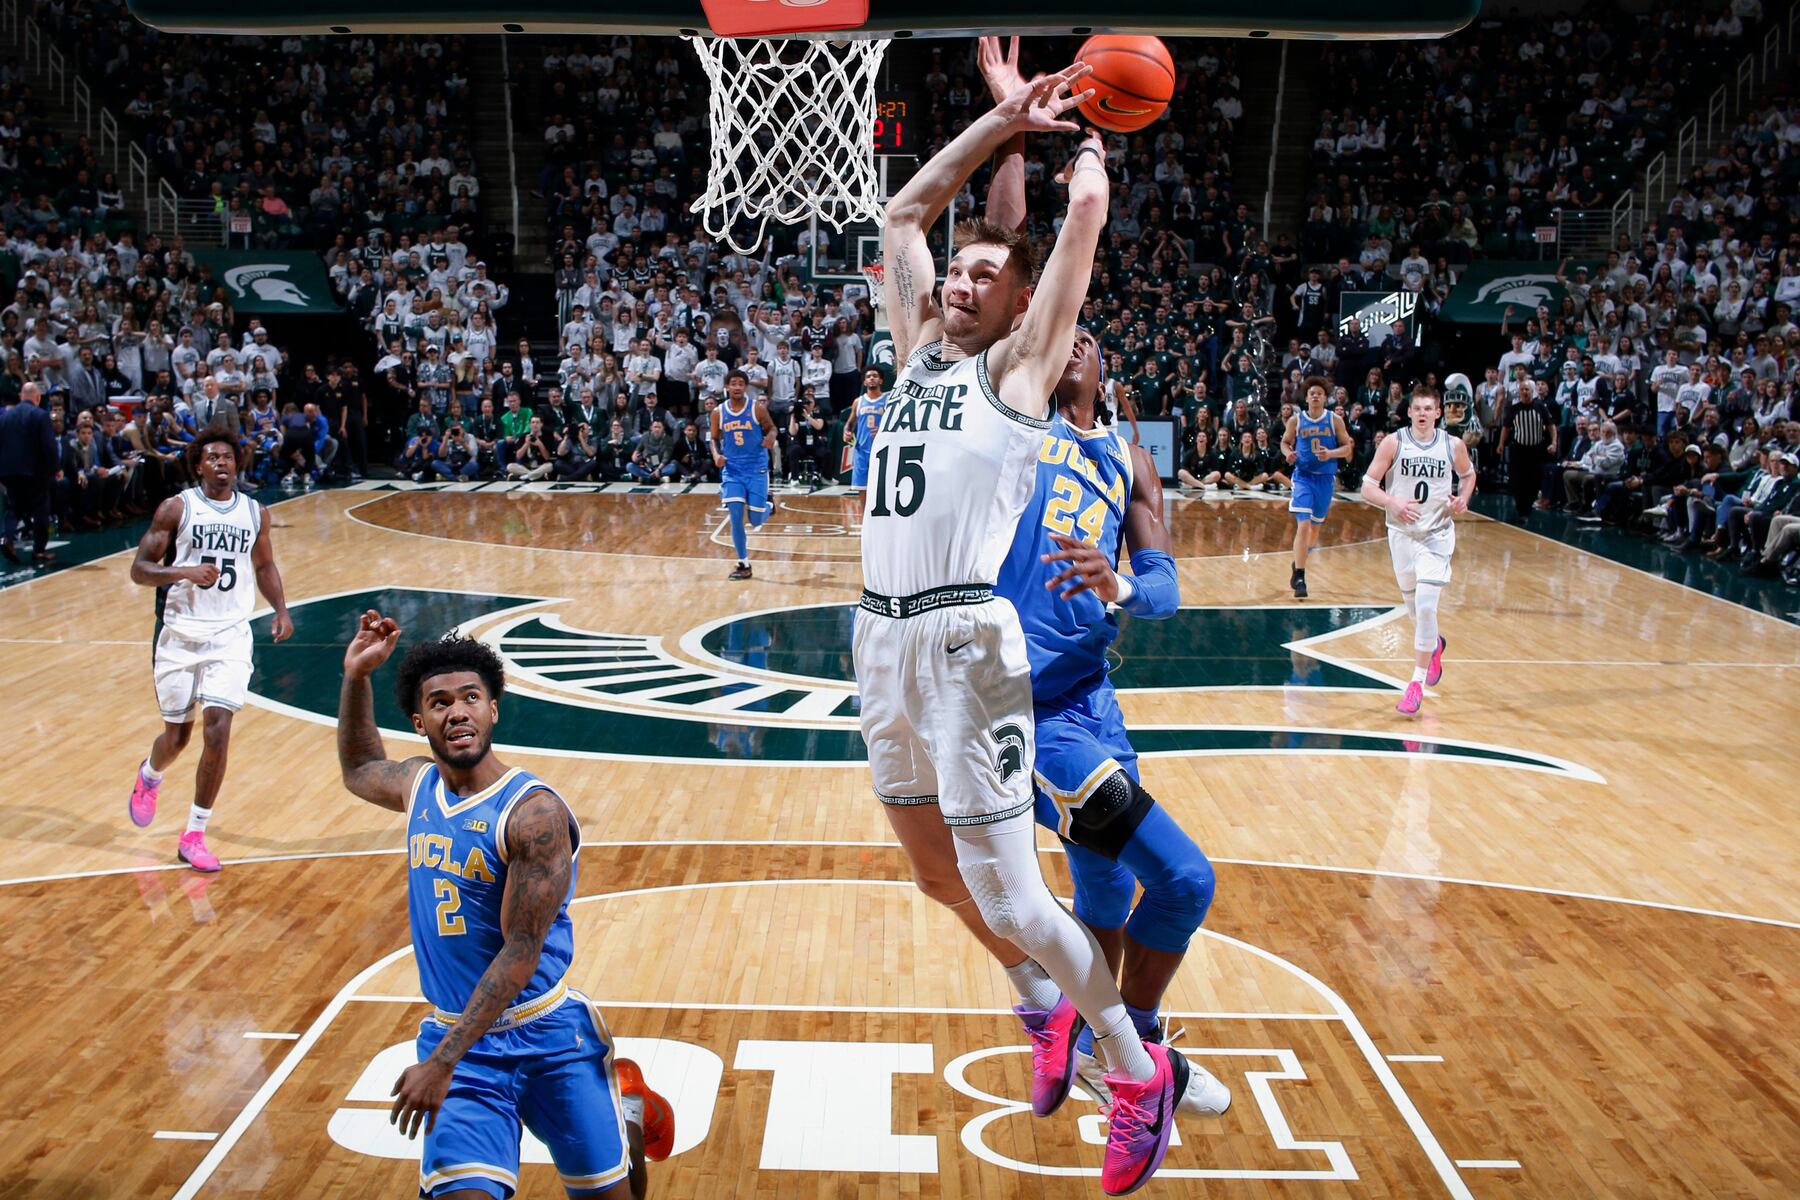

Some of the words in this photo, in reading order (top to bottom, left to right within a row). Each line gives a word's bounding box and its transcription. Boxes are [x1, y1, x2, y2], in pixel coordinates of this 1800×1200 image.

[882, 385, 968, 432] TATE
[724, 421, 753, 432] UCLA
[867, 415, 875, 428] 8
[734, 432, 745, 446] 5
[1300, 427, 1331, 439] UCLA
[1311, 438, 1321, 453] 0
[1401, 457, 1446, 478] STATE
[871, 443, 926, 517] 15
[1414, 480, 1429, 504] 0
[1042, 474, 1108, 549] 24
[192, 525, 251, 553] STATE
[205, 524, 241, 536] MICHIGAN
[198, 556, 238, 592] 55
[889, 597, 901, 618] S
[410, 833, 496, 883] UCLA
[433, 878, 467, 937] 2
